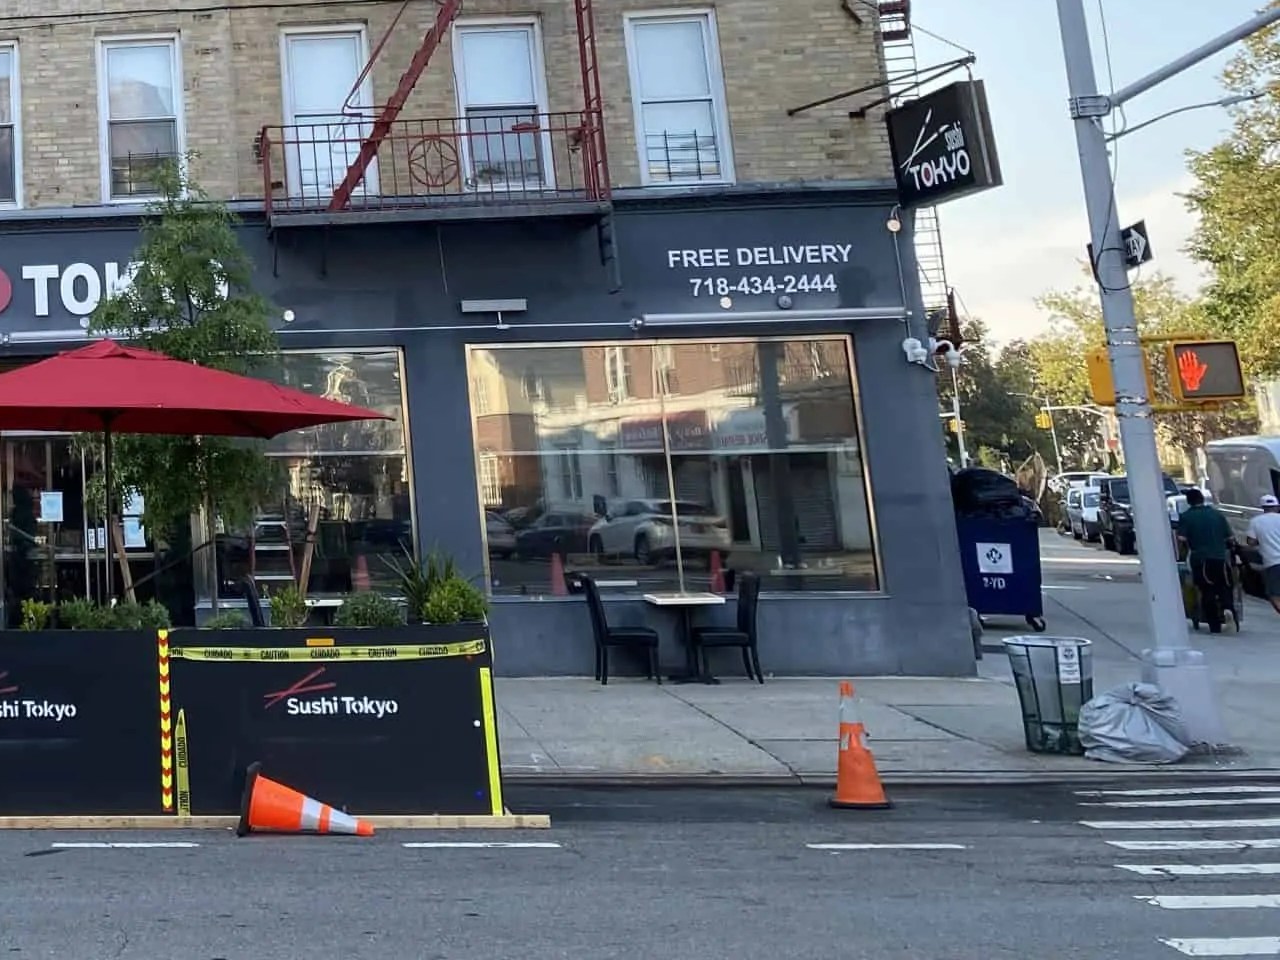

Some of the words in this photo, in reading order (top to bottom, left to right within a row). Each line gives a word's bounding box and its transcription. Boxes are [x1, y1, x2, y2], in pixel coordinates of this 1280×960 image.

[909, 149, 970, 190] TOKYO
[668, 249, 731, 268] FREE
[736, 244, 852, 266] DELIVERY
[22, 259, 229, 316] TOK
[689, 274, 837, 297] 718-434-2444
[260, 650, 290, 660] CAUTION
[368, 648, 397, 658] CAUTION
[22, 700, 77, 721] Tokyo
[287, 697, 338, 715] Sushi
[341, 696, 398, 718] Tokyo
